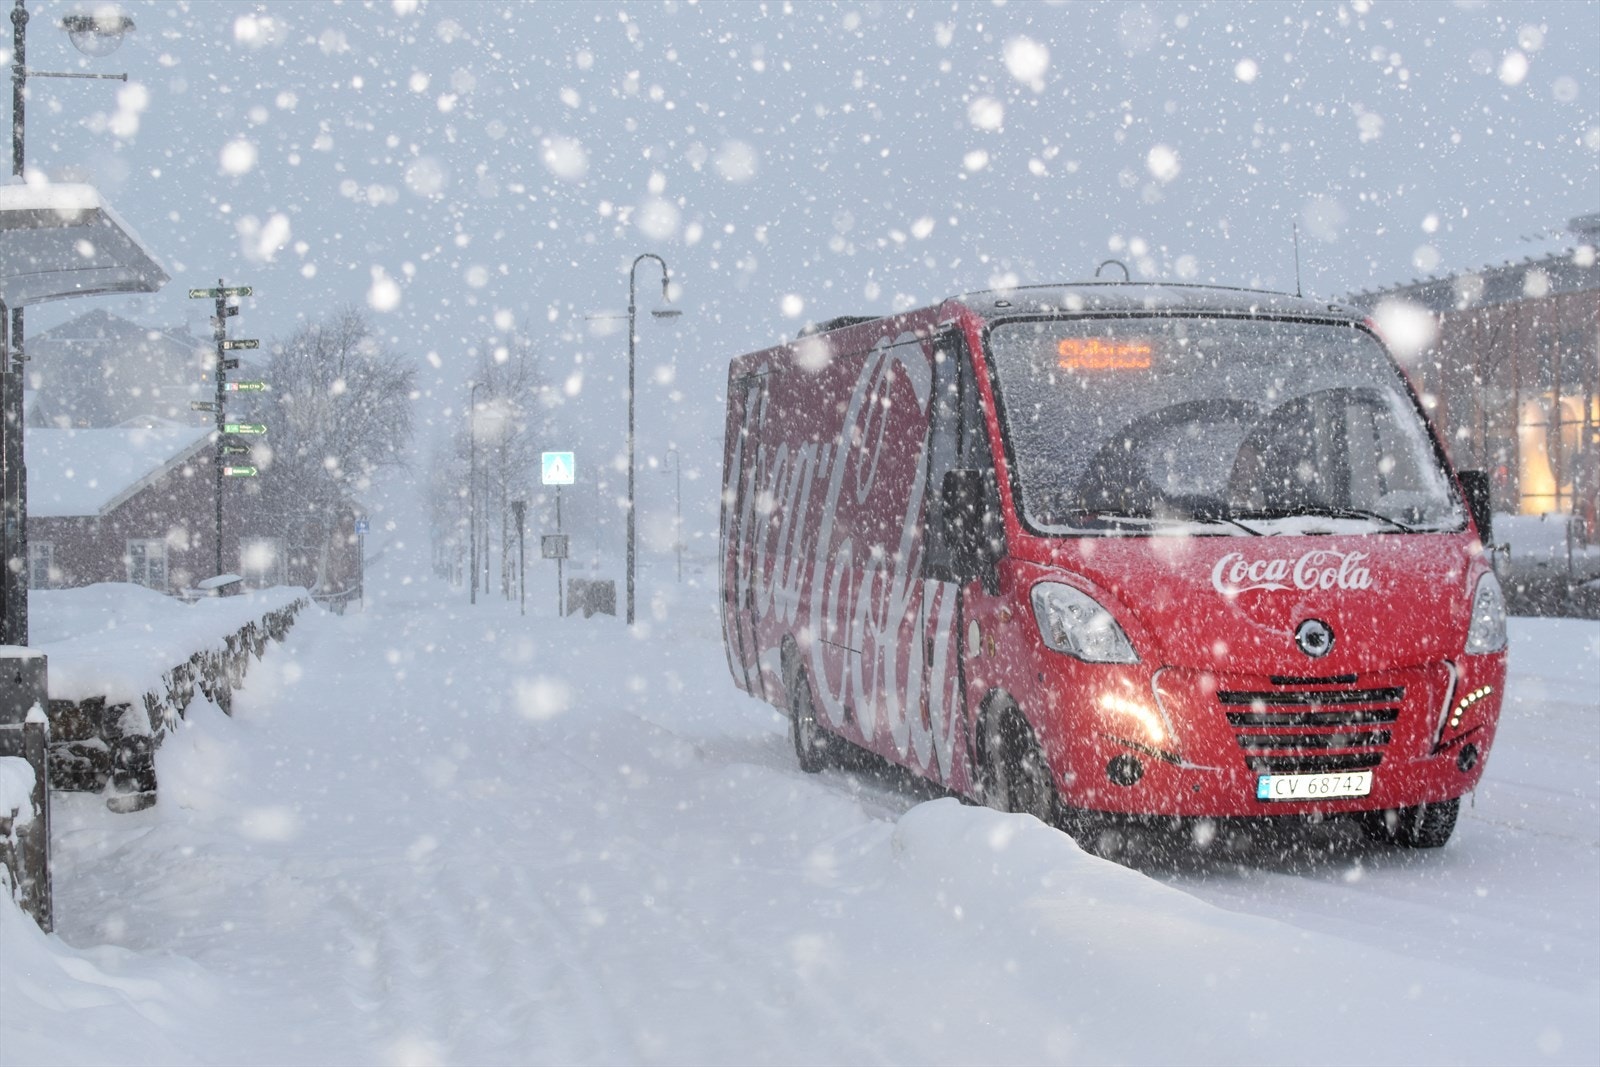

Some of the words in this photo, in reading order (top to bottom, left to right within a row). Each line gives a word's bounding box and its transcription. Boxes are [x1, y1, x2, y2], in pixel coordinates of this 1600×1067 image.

[1211, 550, 1373, 595] Coca-Cola
[1275, 779, 1299, 795] CV
[1308, 775, 1364, 794] 68742
